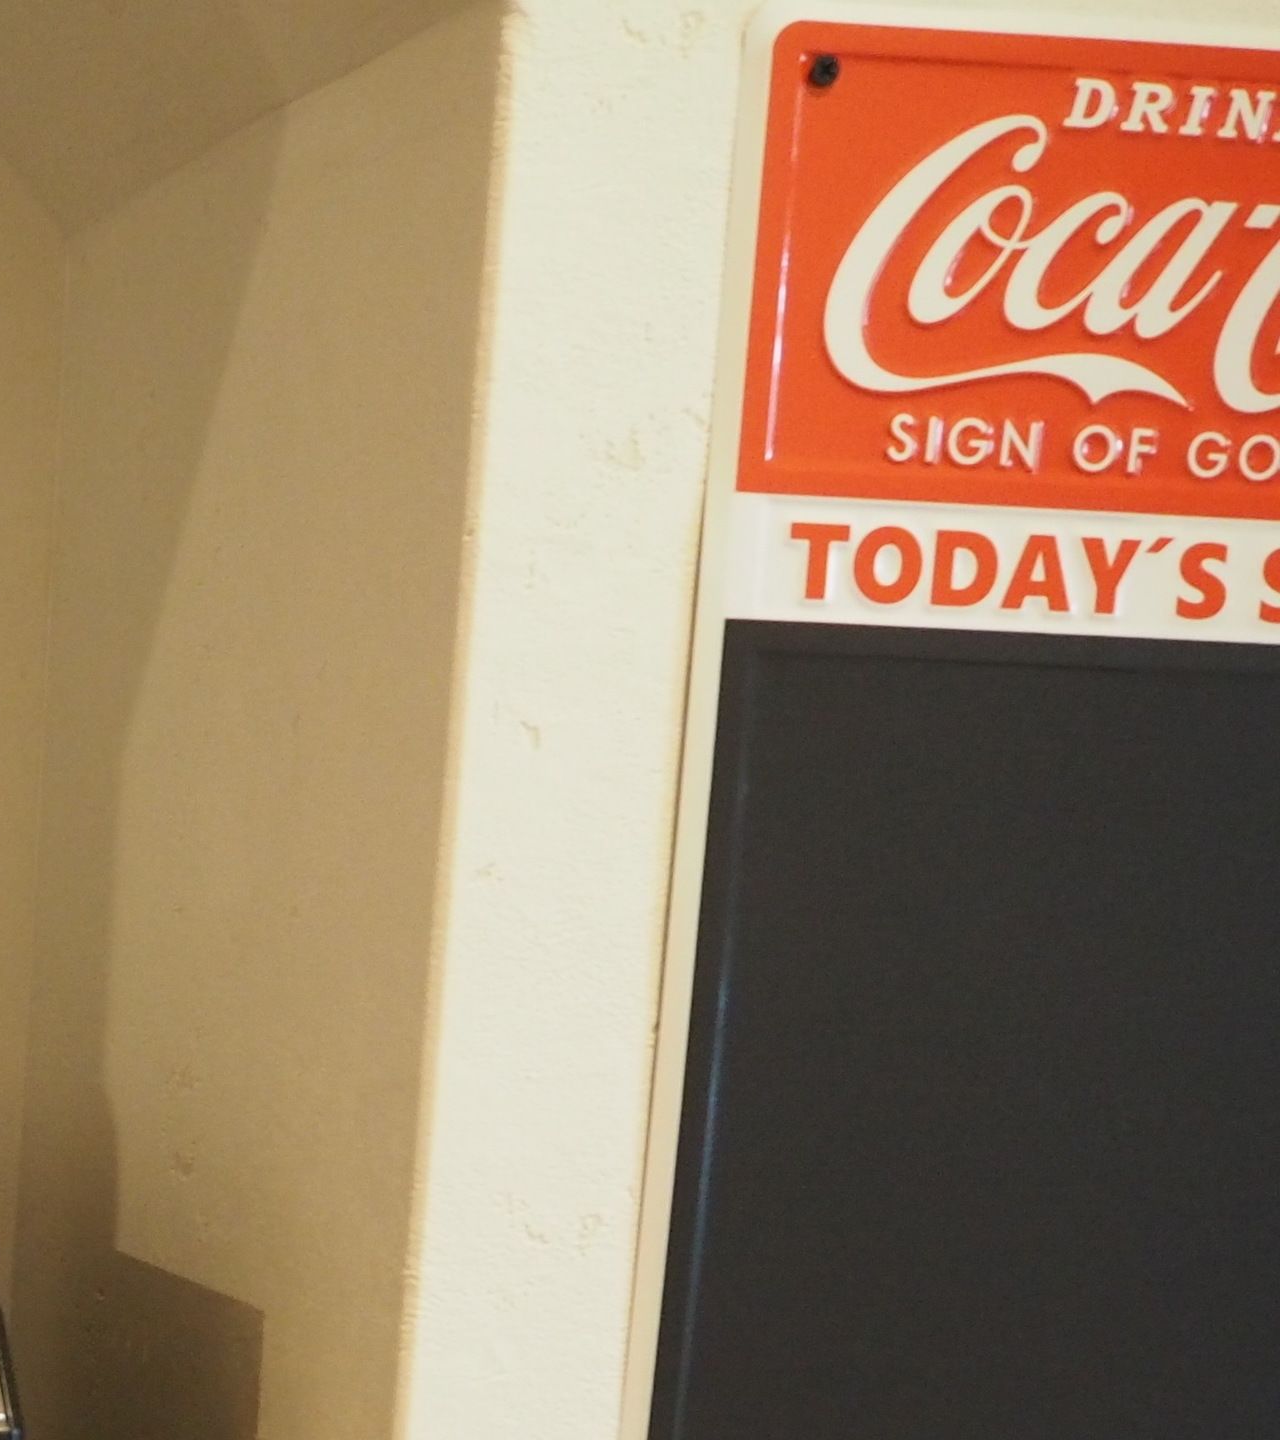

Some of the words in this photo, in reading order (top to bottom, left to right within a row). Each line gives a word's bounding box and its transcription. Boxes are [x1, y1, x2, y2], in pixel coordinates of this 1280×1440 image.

[1064, 76, 1280, 142] DRIN
[885, 411, 1045, 469] SIGN
[1072, 423, 1158, 475] OF
[790, 521, 1229, 622] TODAY'S
